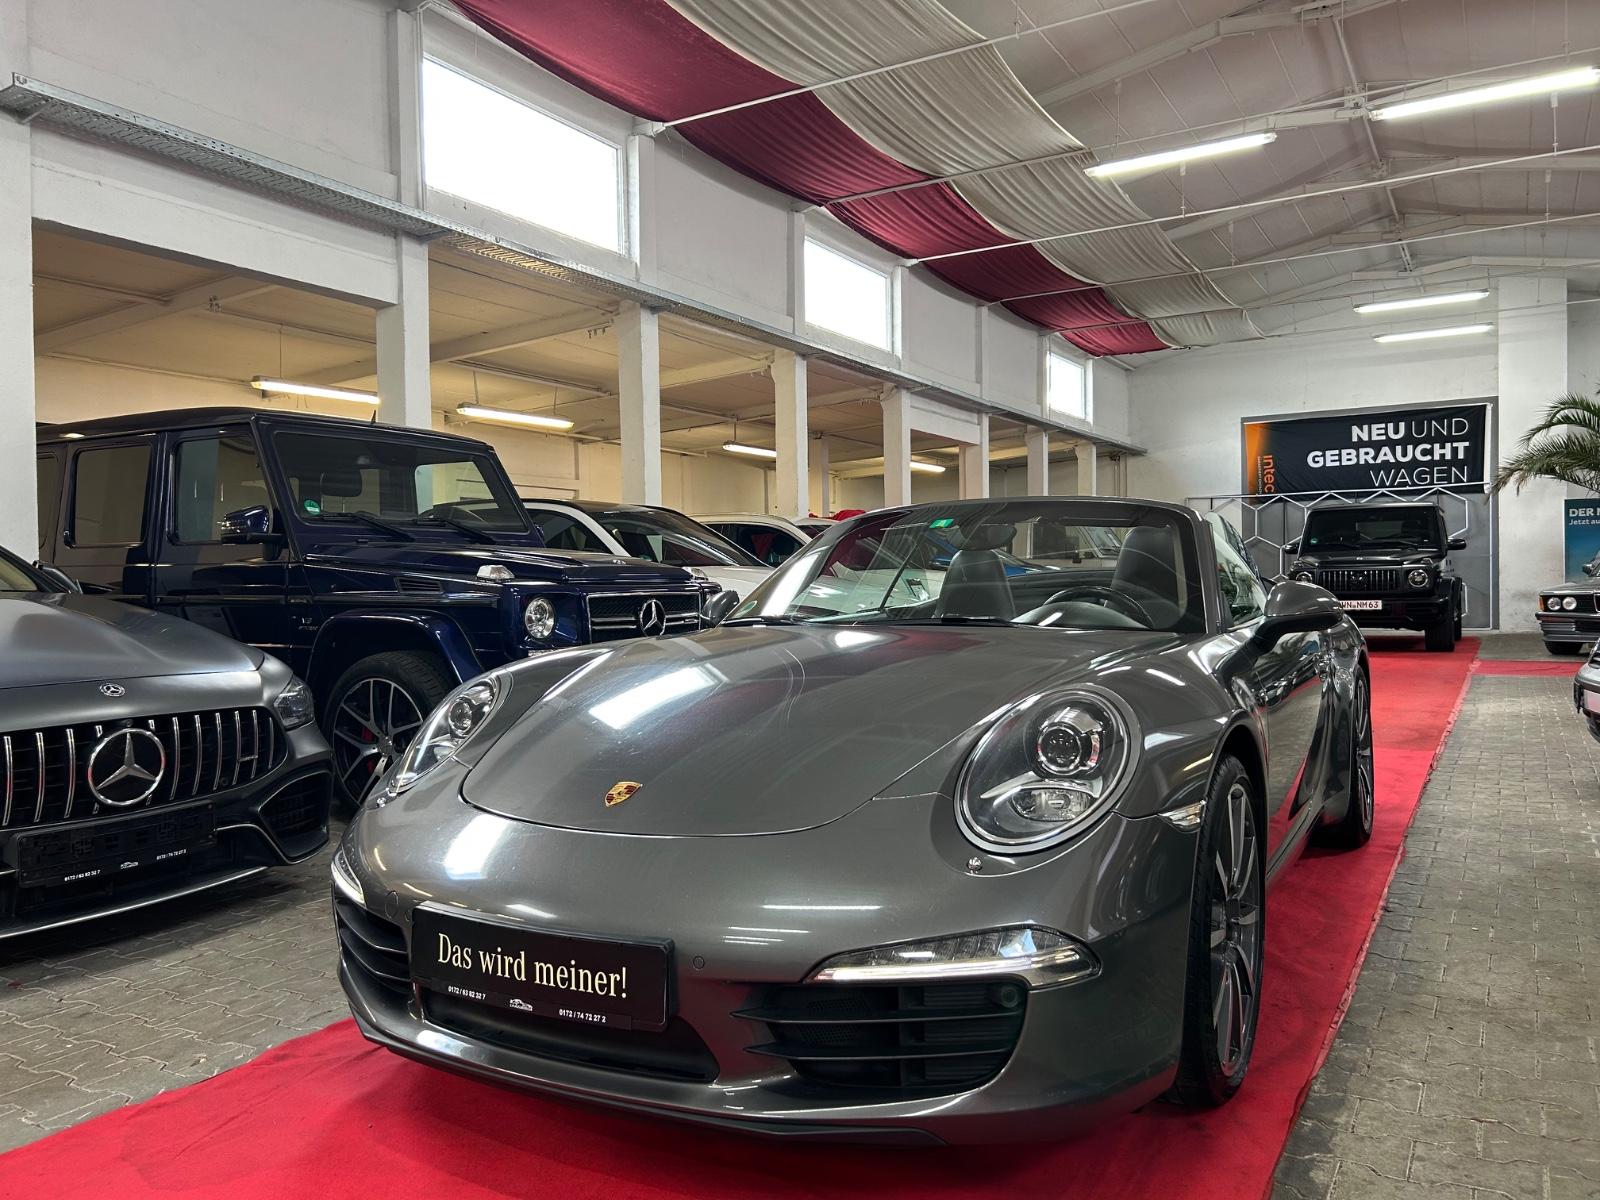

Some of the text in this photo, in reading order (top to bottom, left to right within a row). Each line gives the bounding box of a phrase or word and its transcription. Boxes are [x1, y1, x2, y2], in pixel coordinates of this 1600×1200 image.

[1351, 418, 1468, 442] NEU UND
[1306, 442, 1470, 468] GEBRAUCHT
[1370, 466, 1468, 486] WAGEN
[1569, 508, 1594, 516] DER
[438, 933, 627, 998] Das wird meiner!
